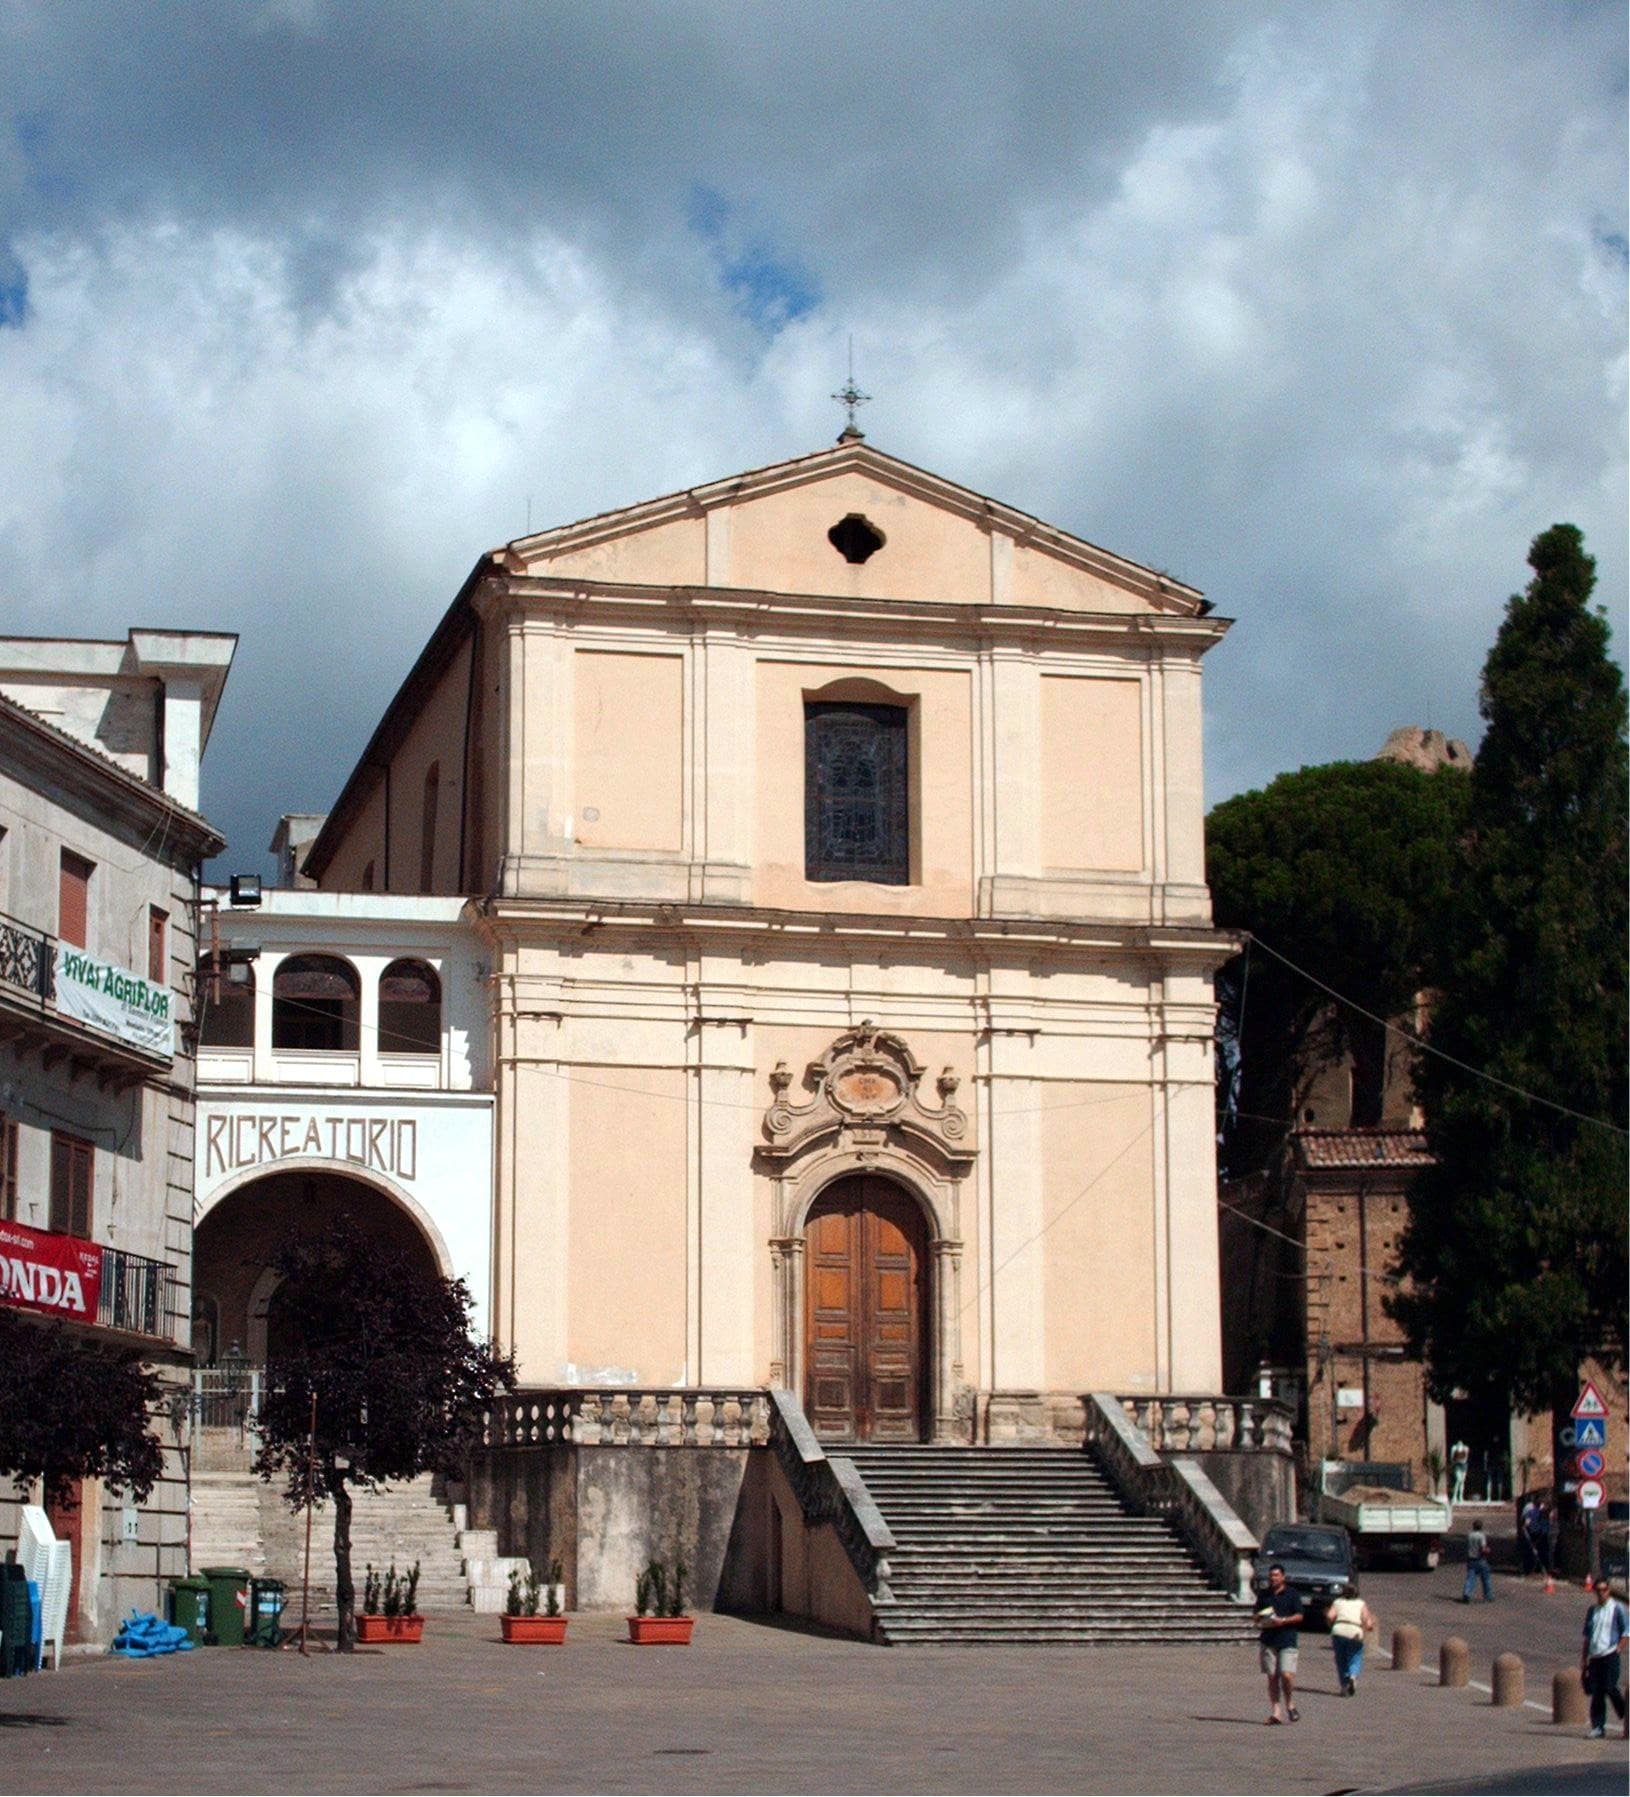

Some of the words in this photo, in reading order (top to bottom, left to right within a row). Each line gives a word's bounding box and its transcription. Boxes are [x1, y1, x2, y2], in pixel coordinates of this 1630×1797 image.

[63, 951, 101, 990] VIVAI
[103, 966, 169, 1019] AGRIFLOR
[206, 1114, 417, 1181] RICREATORIO
